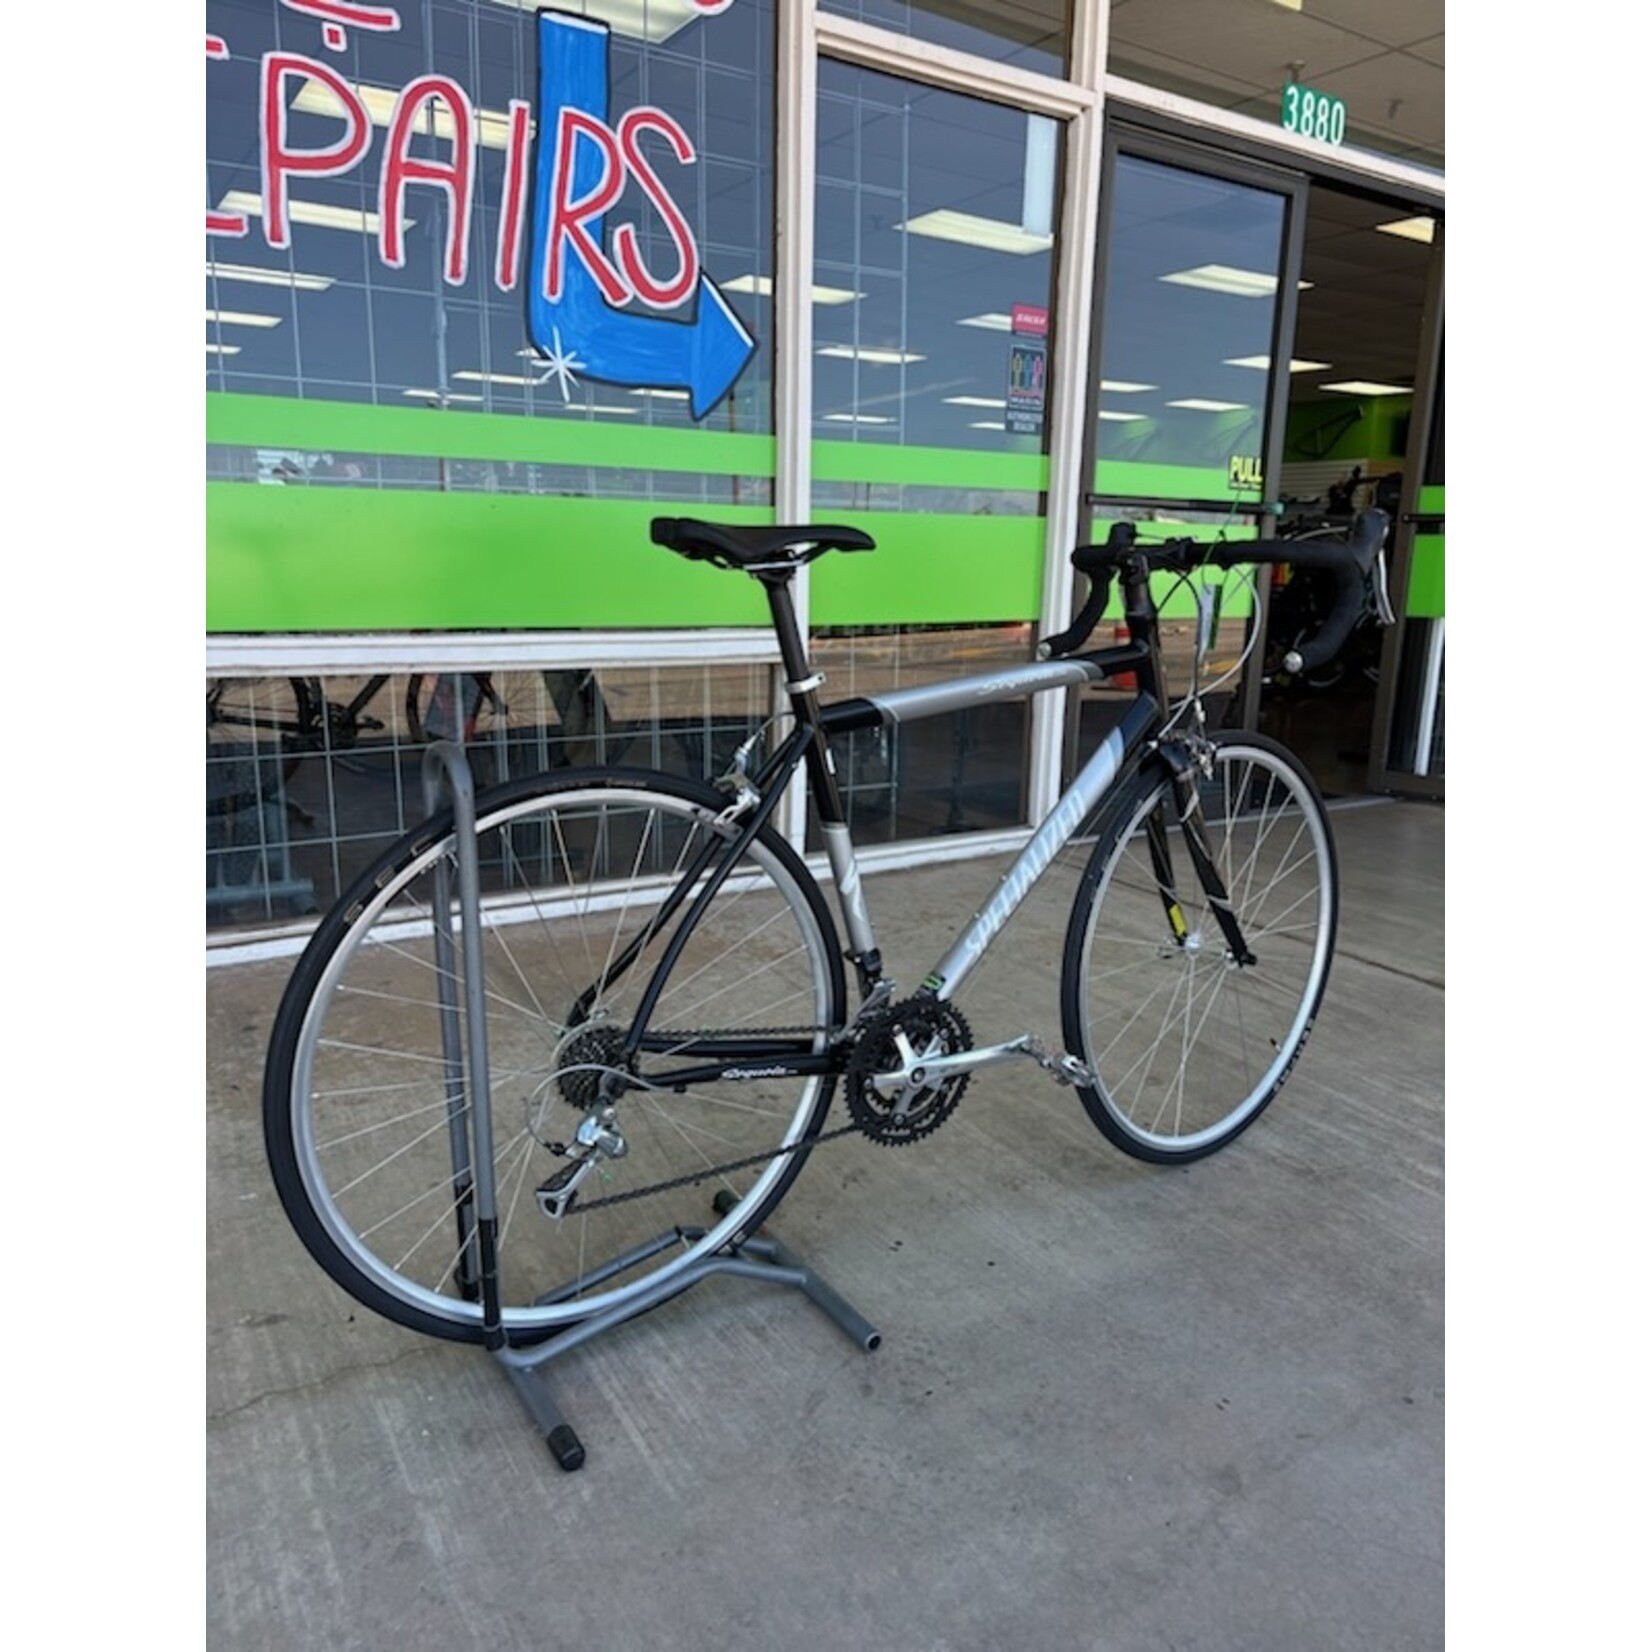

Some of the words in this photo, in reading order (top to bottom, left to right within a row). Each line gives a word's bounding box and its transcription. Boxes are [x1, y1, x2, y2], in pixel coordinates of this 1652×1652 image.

[1283, 85, 1345, 146] 3880
[206, 36, 696, 309] PAIRS
[1230, 455, 1263, 482] PULL
[965, 789, 1086, 954] SPECIALIZED
